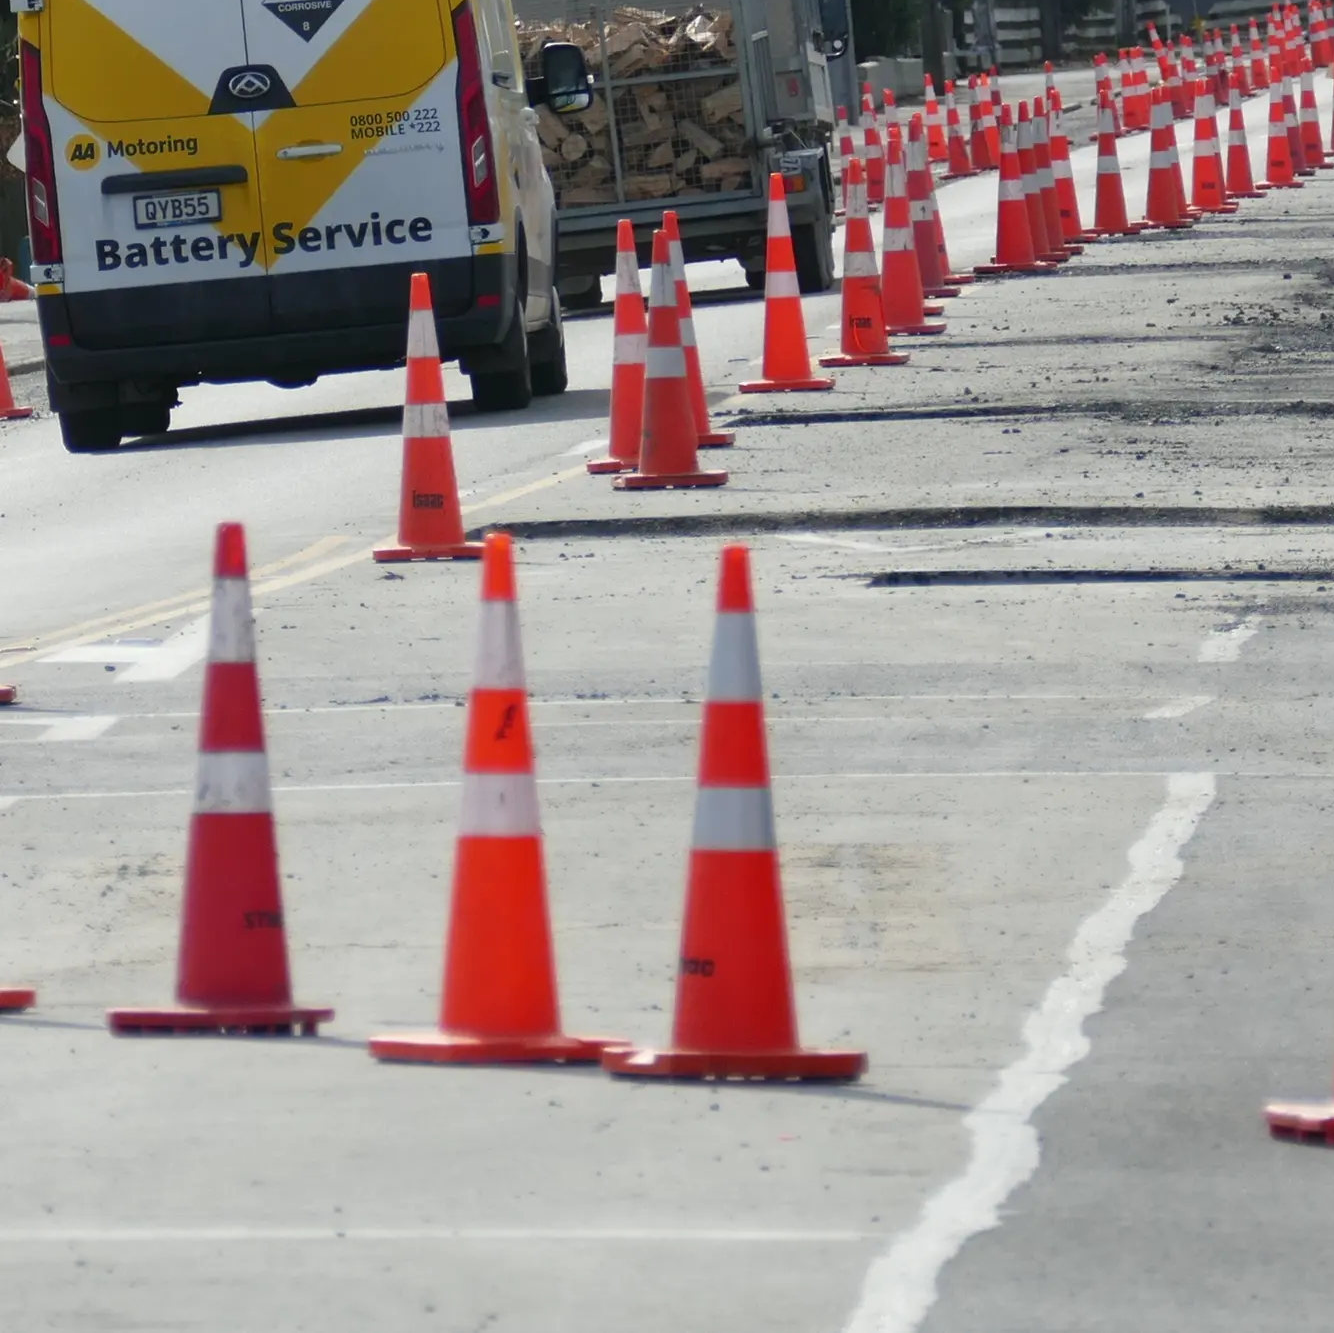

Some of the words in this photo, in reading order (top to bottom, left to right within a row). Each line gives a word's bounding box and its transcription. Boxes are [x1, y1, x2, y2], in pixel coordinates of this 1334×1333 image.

[277, 0, 332, 12] CORROSIVE
[302, 21, 310, 31] 8
[350, 113, 383, 127] 0800
[386, 110, 410, 124] 500
[414, 108, 438, 121] 222
[351, 123, 405, 139] MOBILE
[70, 142, 95, 161] AA
[107, 135, 198, 159] Motoring
[144, 196, 210, 221] QYB55
[95, 231, 261, 271] Battery
[272, 212, 432, 255] Service
